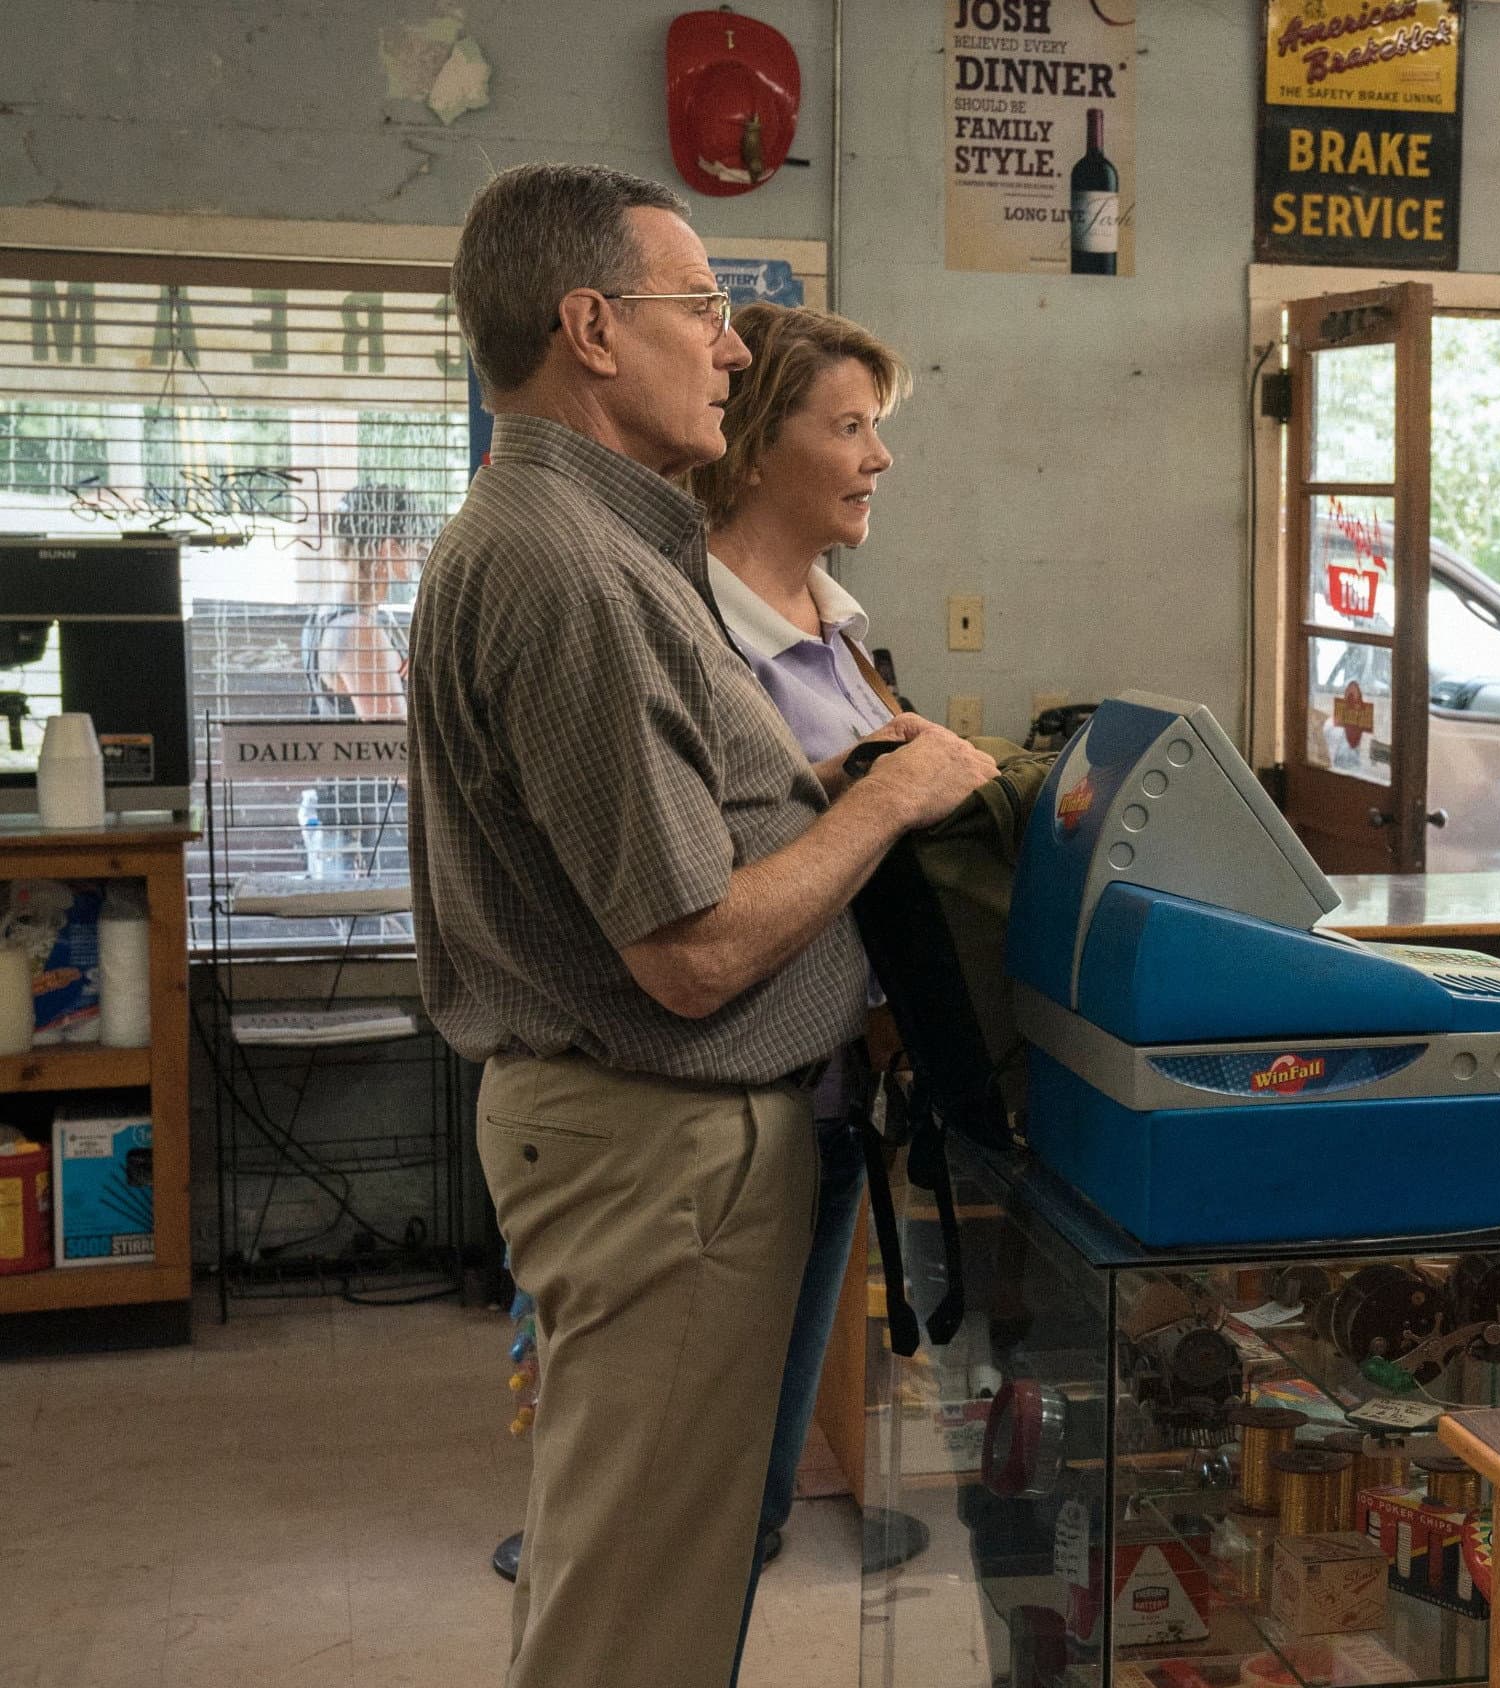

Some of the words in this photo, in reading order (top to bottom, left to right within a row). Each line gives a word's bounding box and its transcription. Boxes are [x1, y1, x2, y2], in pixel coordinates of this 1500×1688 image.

[955, 0, 1051, 33] JOSH
[1278, 1, 1418, 57] American
[954, 35, 1019, 52] BELIEVED
[1024, 39, 1069, 55] EVERY
[1302, 18, 1450, 84] Brakeblok
[955, 55, 1116, 98] DINNER
[954, 97, 1007, 113] SHOULD
[1011, 101, 1026, 114] BE
[1280, 85, 1302, 98] THE
[1307, 87, 1353, 100] SAFETY
[1358, 90, 1398, 103] BRAKE
[1402, 93, 1442, 105] LINING
[955, 116, 1053, 141] FAMILY
[955, 145, 1063, 178] STYLE.
[1288, 128, 1432, 178] BRAKE
[1004, 206, 1047, 222] LONG
[1051, 208, 1086, 225] LIVE
[1271, 191, 1445, 241] SERVICE
[715, 273, 759, 286] OTTERY
[239, 742, 325, 763] DAILY
[1255, 1062, 1321, 1088] WinFall
[1379, 1501, 1414, 1521] POKER
[1419, 1514, 1454, 1533] CHIPS
